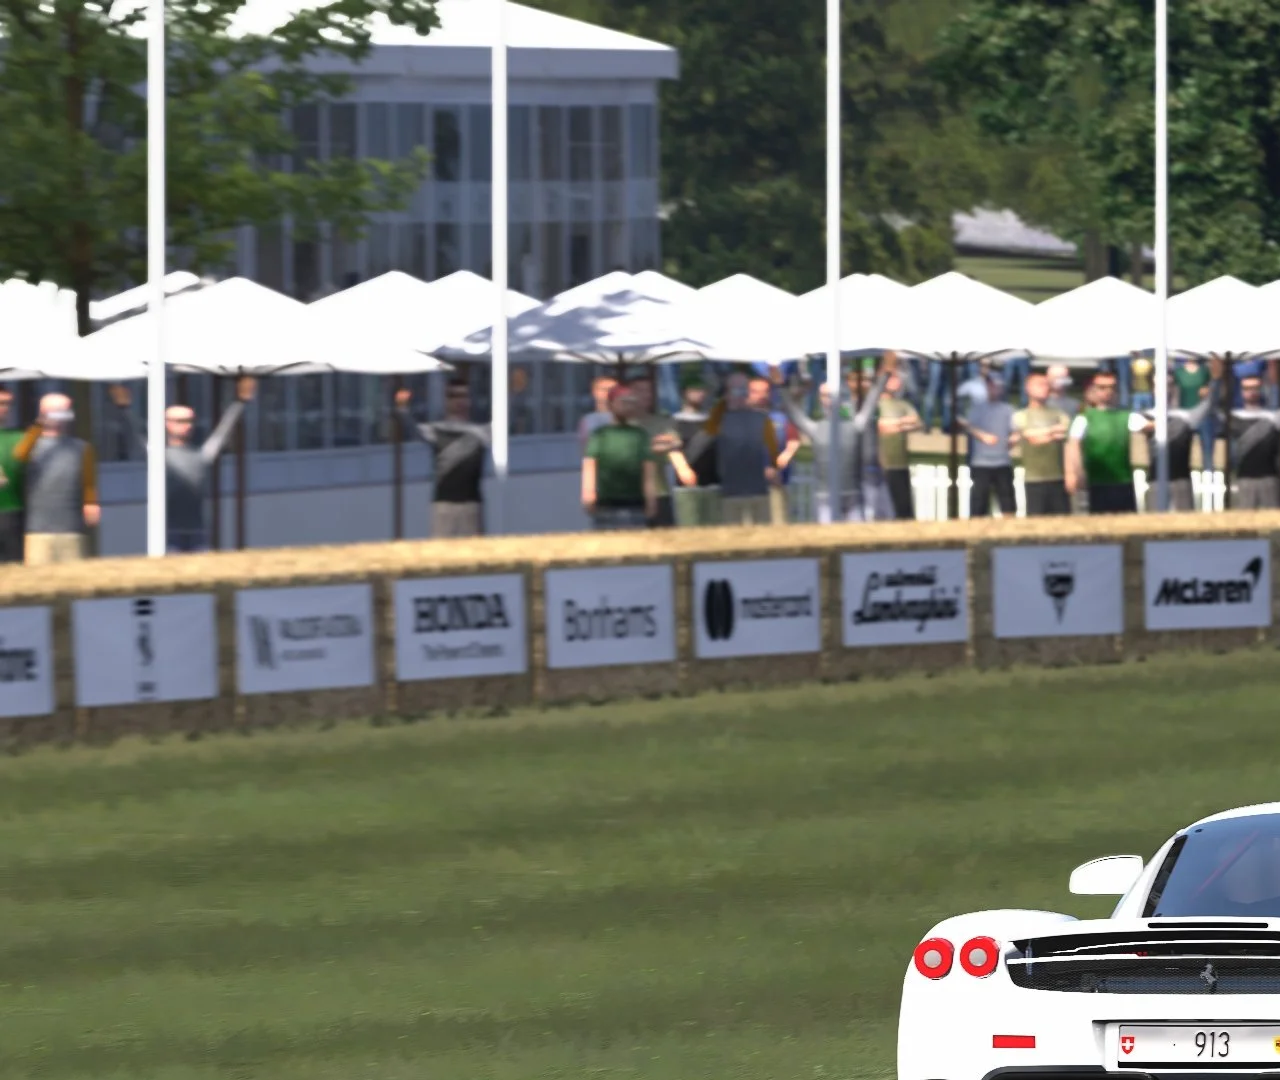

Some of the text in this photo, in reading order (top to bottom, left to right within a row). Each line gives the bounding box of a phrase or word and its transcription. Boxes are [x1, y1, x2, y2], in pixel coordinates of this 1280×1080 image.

[1154, 577, 1253, 606] McLaren
[413, 593, 510, 634] HONDA
[563, 596, 657, 642] Bonhams
[1195, 1031, 1231, 1058] 913
